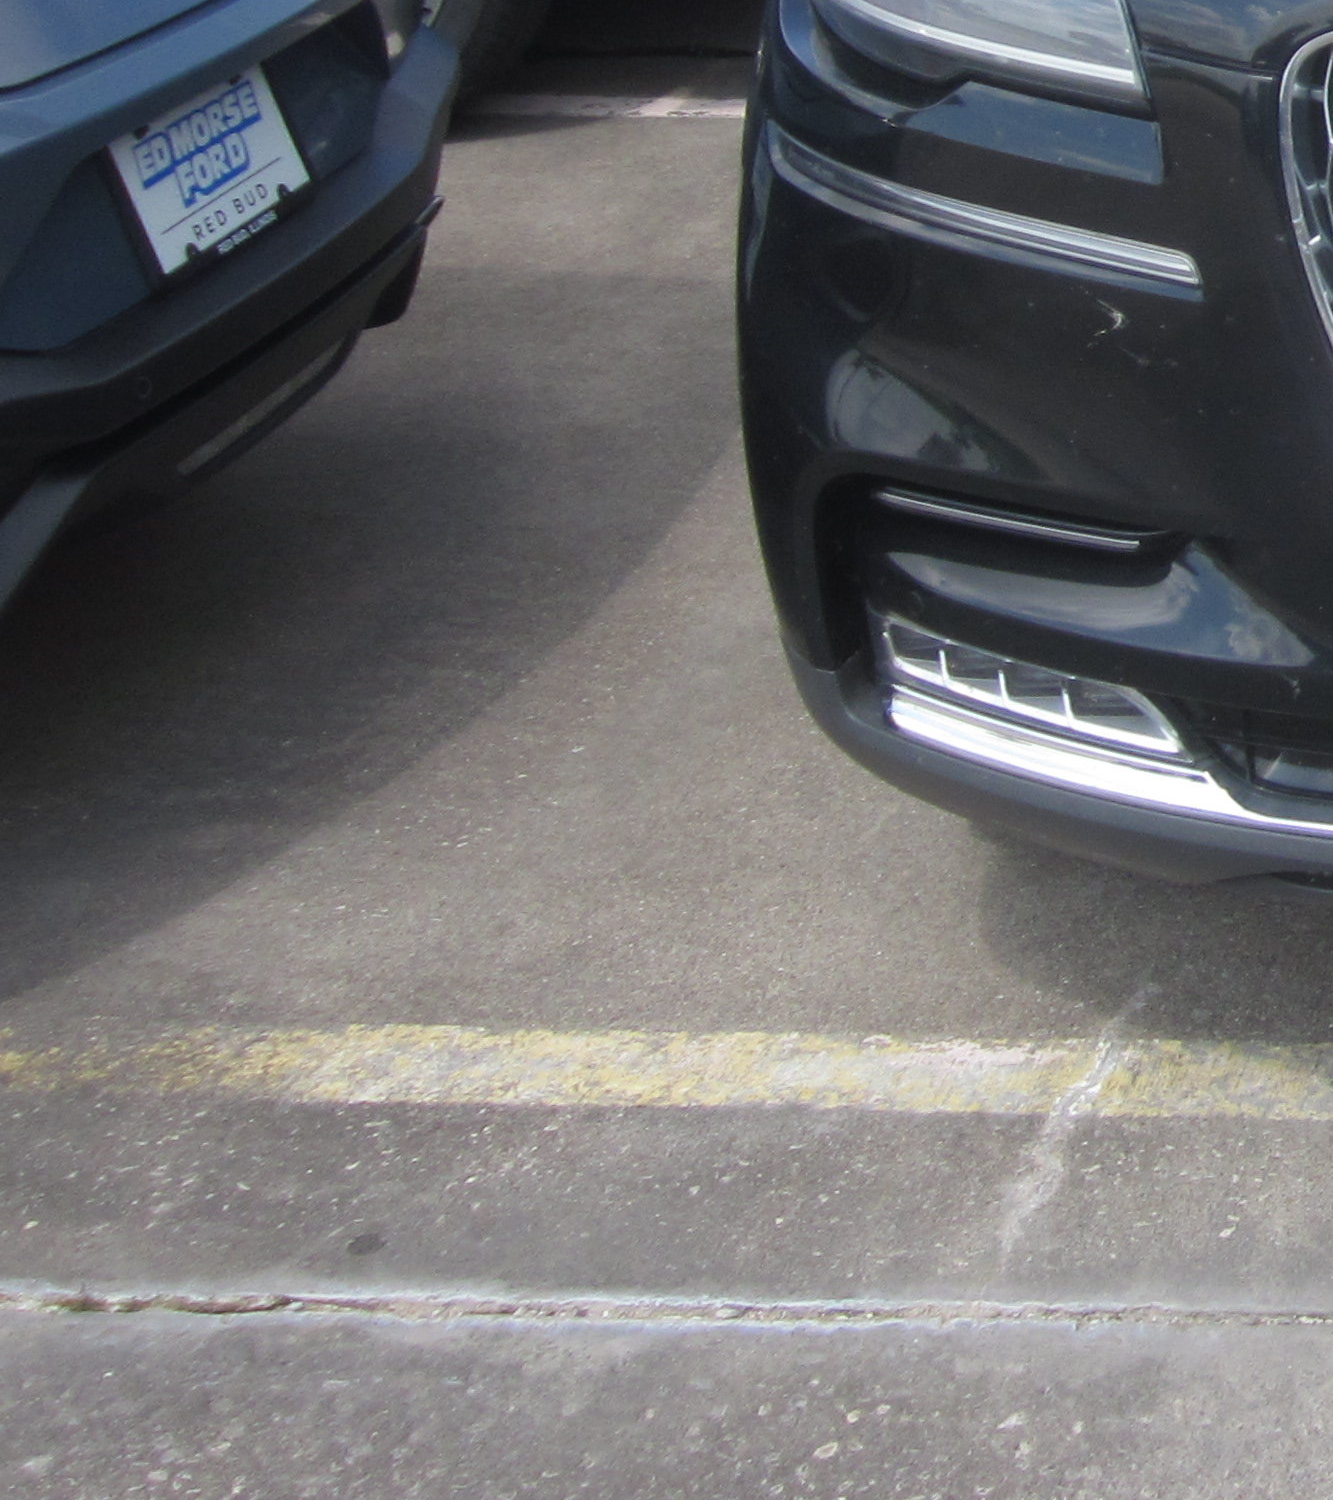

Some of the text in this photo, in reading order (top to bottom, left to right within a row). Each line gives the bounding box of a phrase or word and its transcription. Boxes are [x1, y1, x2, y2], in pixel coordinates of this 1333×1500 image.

[134, 81, 261, 185] ED MORSE
[176, 133, 248, 202] FORD
[193, 209, 228, 240] RED
[234, 183, 268, 213] BUD
